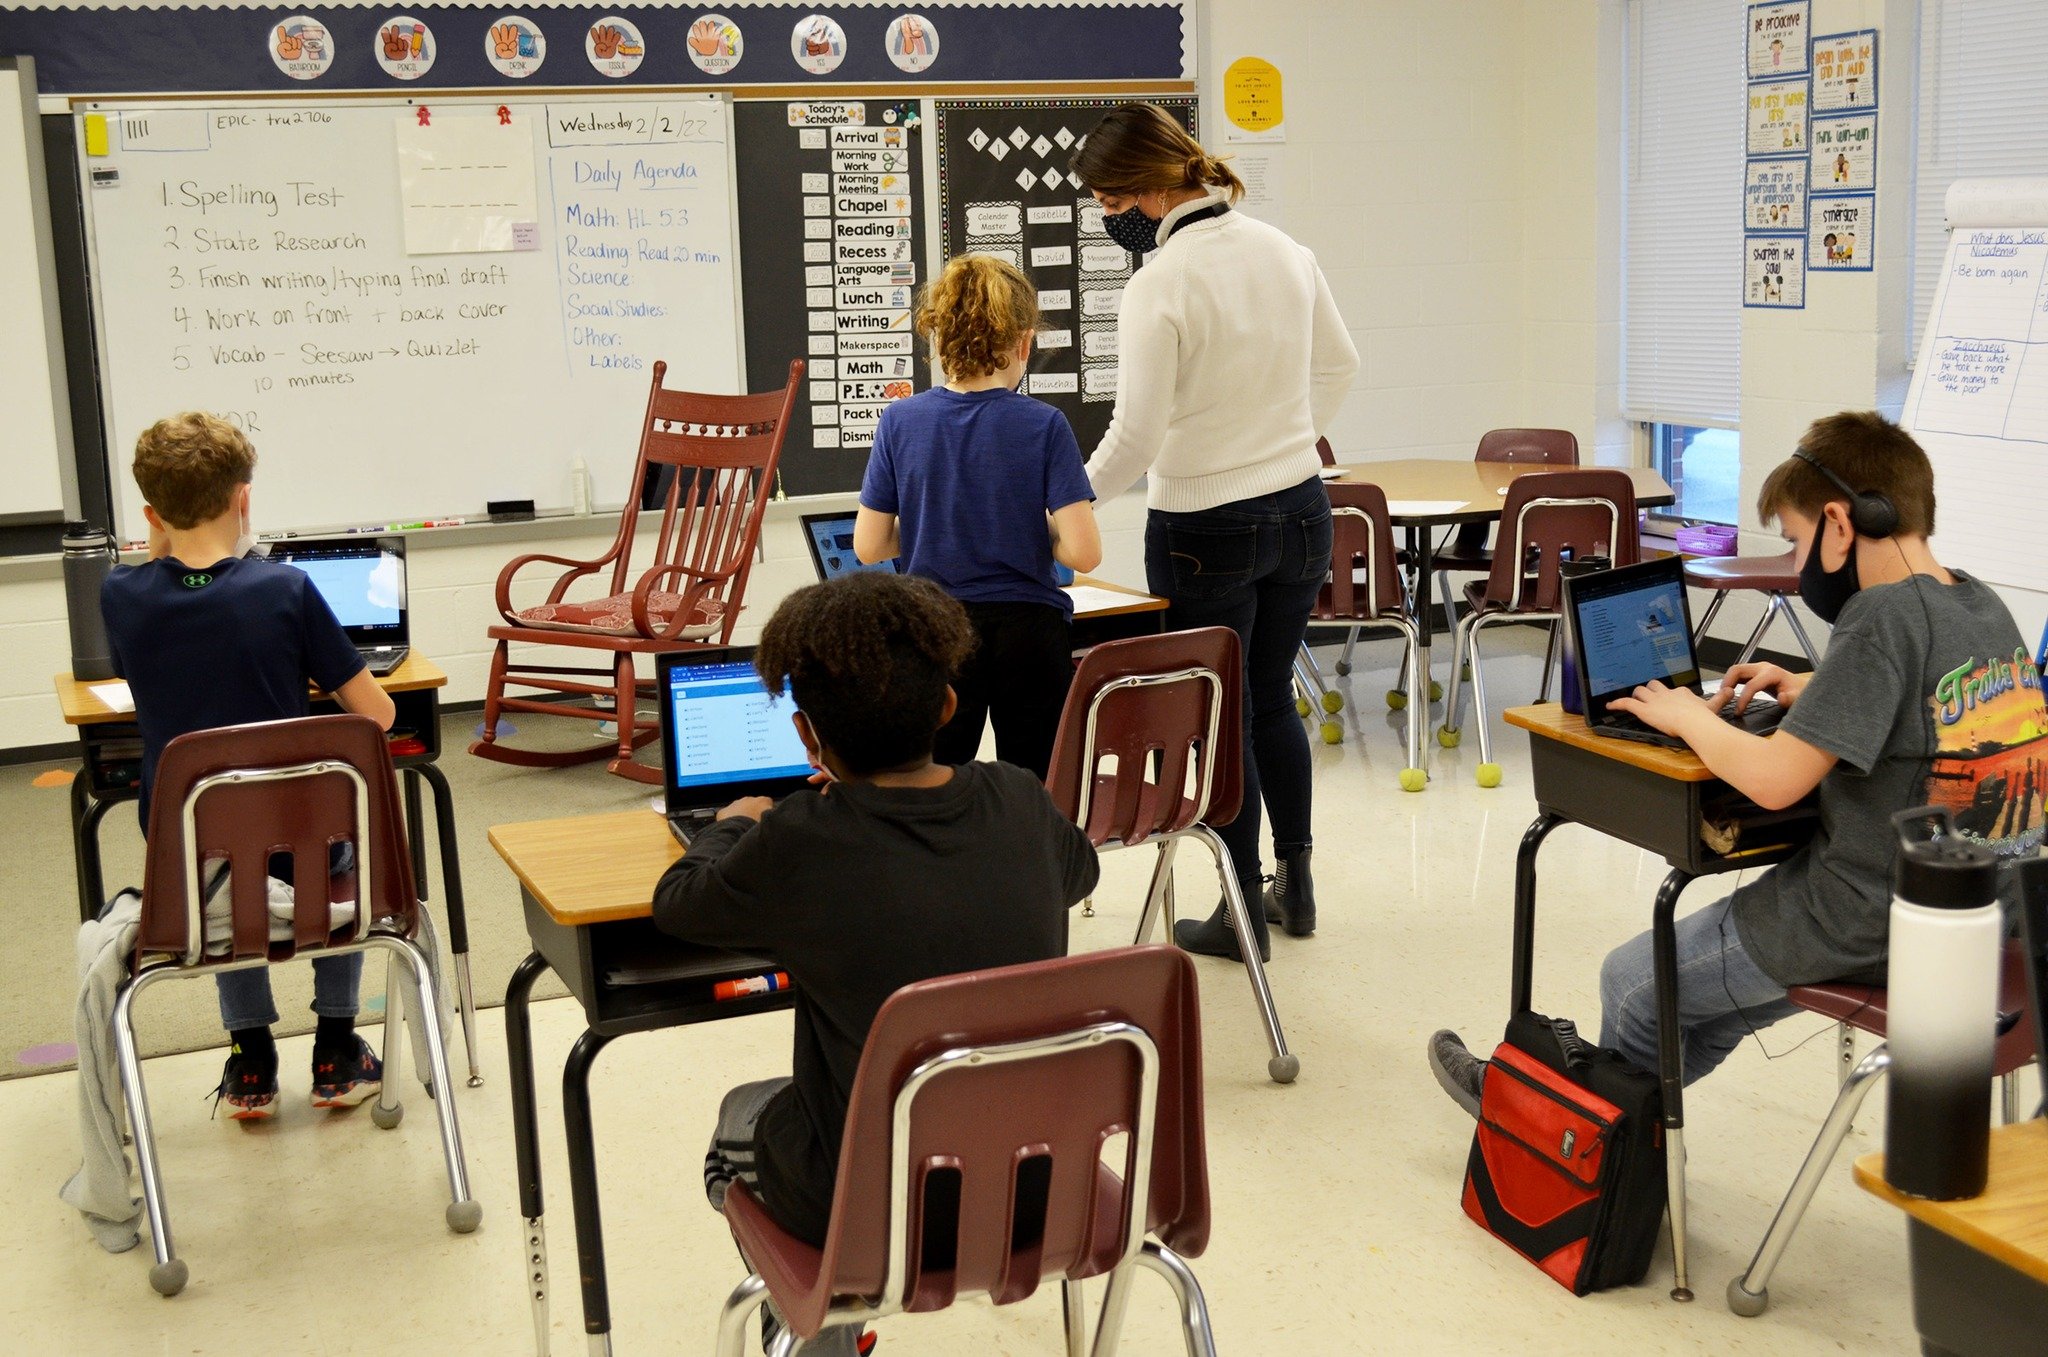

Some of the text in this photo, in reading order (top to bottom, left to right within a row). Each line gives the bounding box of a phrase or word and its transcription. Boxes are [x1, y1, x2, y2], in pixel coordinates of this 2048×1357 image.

[508, 61, 527, 70] DRINK
[608, 61, 627, 70] TISSUE
[703, 58, 730, 67] QUESTION
[816, 58, 826, 67] YES
[909, 57, 919, 65] NO
[397, 63, 418, 72] PENCIL
[808, 105, 845, 117] Today's
[560, 112, 633, 132] Wednesday
[805, 115, 849, 124] Schedule
[835, 132, 878, 143] Arrival
[836, 151, 877, 161] Morning
[844, 162, 869, 171] Work
[575, 159, 698, 191] Daily Agenda
[838, 175, 879, 185] Morning
[839, 185, 879, 195] Meeting
[180, 180, 278, 217] Spelling
[286, 181, 345, 208] Test
[838, 200, 888, 214] Chapel
[628, 208, 652, 229] HL
[837, 224, 894, 238] Reading
[981, 223, 1007, 231] Master
[194, 227, 260, 253] State
[276, 230, 366, 252] Research
[637, 238, 669, 261] Read
[695, 250, 720, 264] min
[839, 247, 887, 258] Recess
[1037, 253, 1065, 263] David
[837, 264, 890, 275] Language
[199, 264, 250, 289] Finish
[261, 266, 402, 297] writing/typing
[410, 264, 450, 288] final
[461, 265, 508, 286] draft
[838, 276, 861, 286] Arts
[2000, 268, 2028, 285] again
[842, 292, 883, 305] Lunch
[205, 309, 261, 332] Work
[273, 310, 294, 326] on
[305, 301, 352, 326] front
[400, 303, 444, 324] back
[837, 315, 890, 329] Writing
[209, 345, 266, 366] Vocab
[300, 343, 374, 366] Seesaw
[406, 338, 481, 359] Quizlet
[839, 342, 900, 351] Makerspace
[590, 353, 643, 370] Labels
[846, 362, 883, 375] Math
[253, 371, 355, 394] 10 minutes
[843, 384, 870, 399] P.E.
[844, 409, 873, 419] Pack
[843, 430, 876, 442] Dismi
